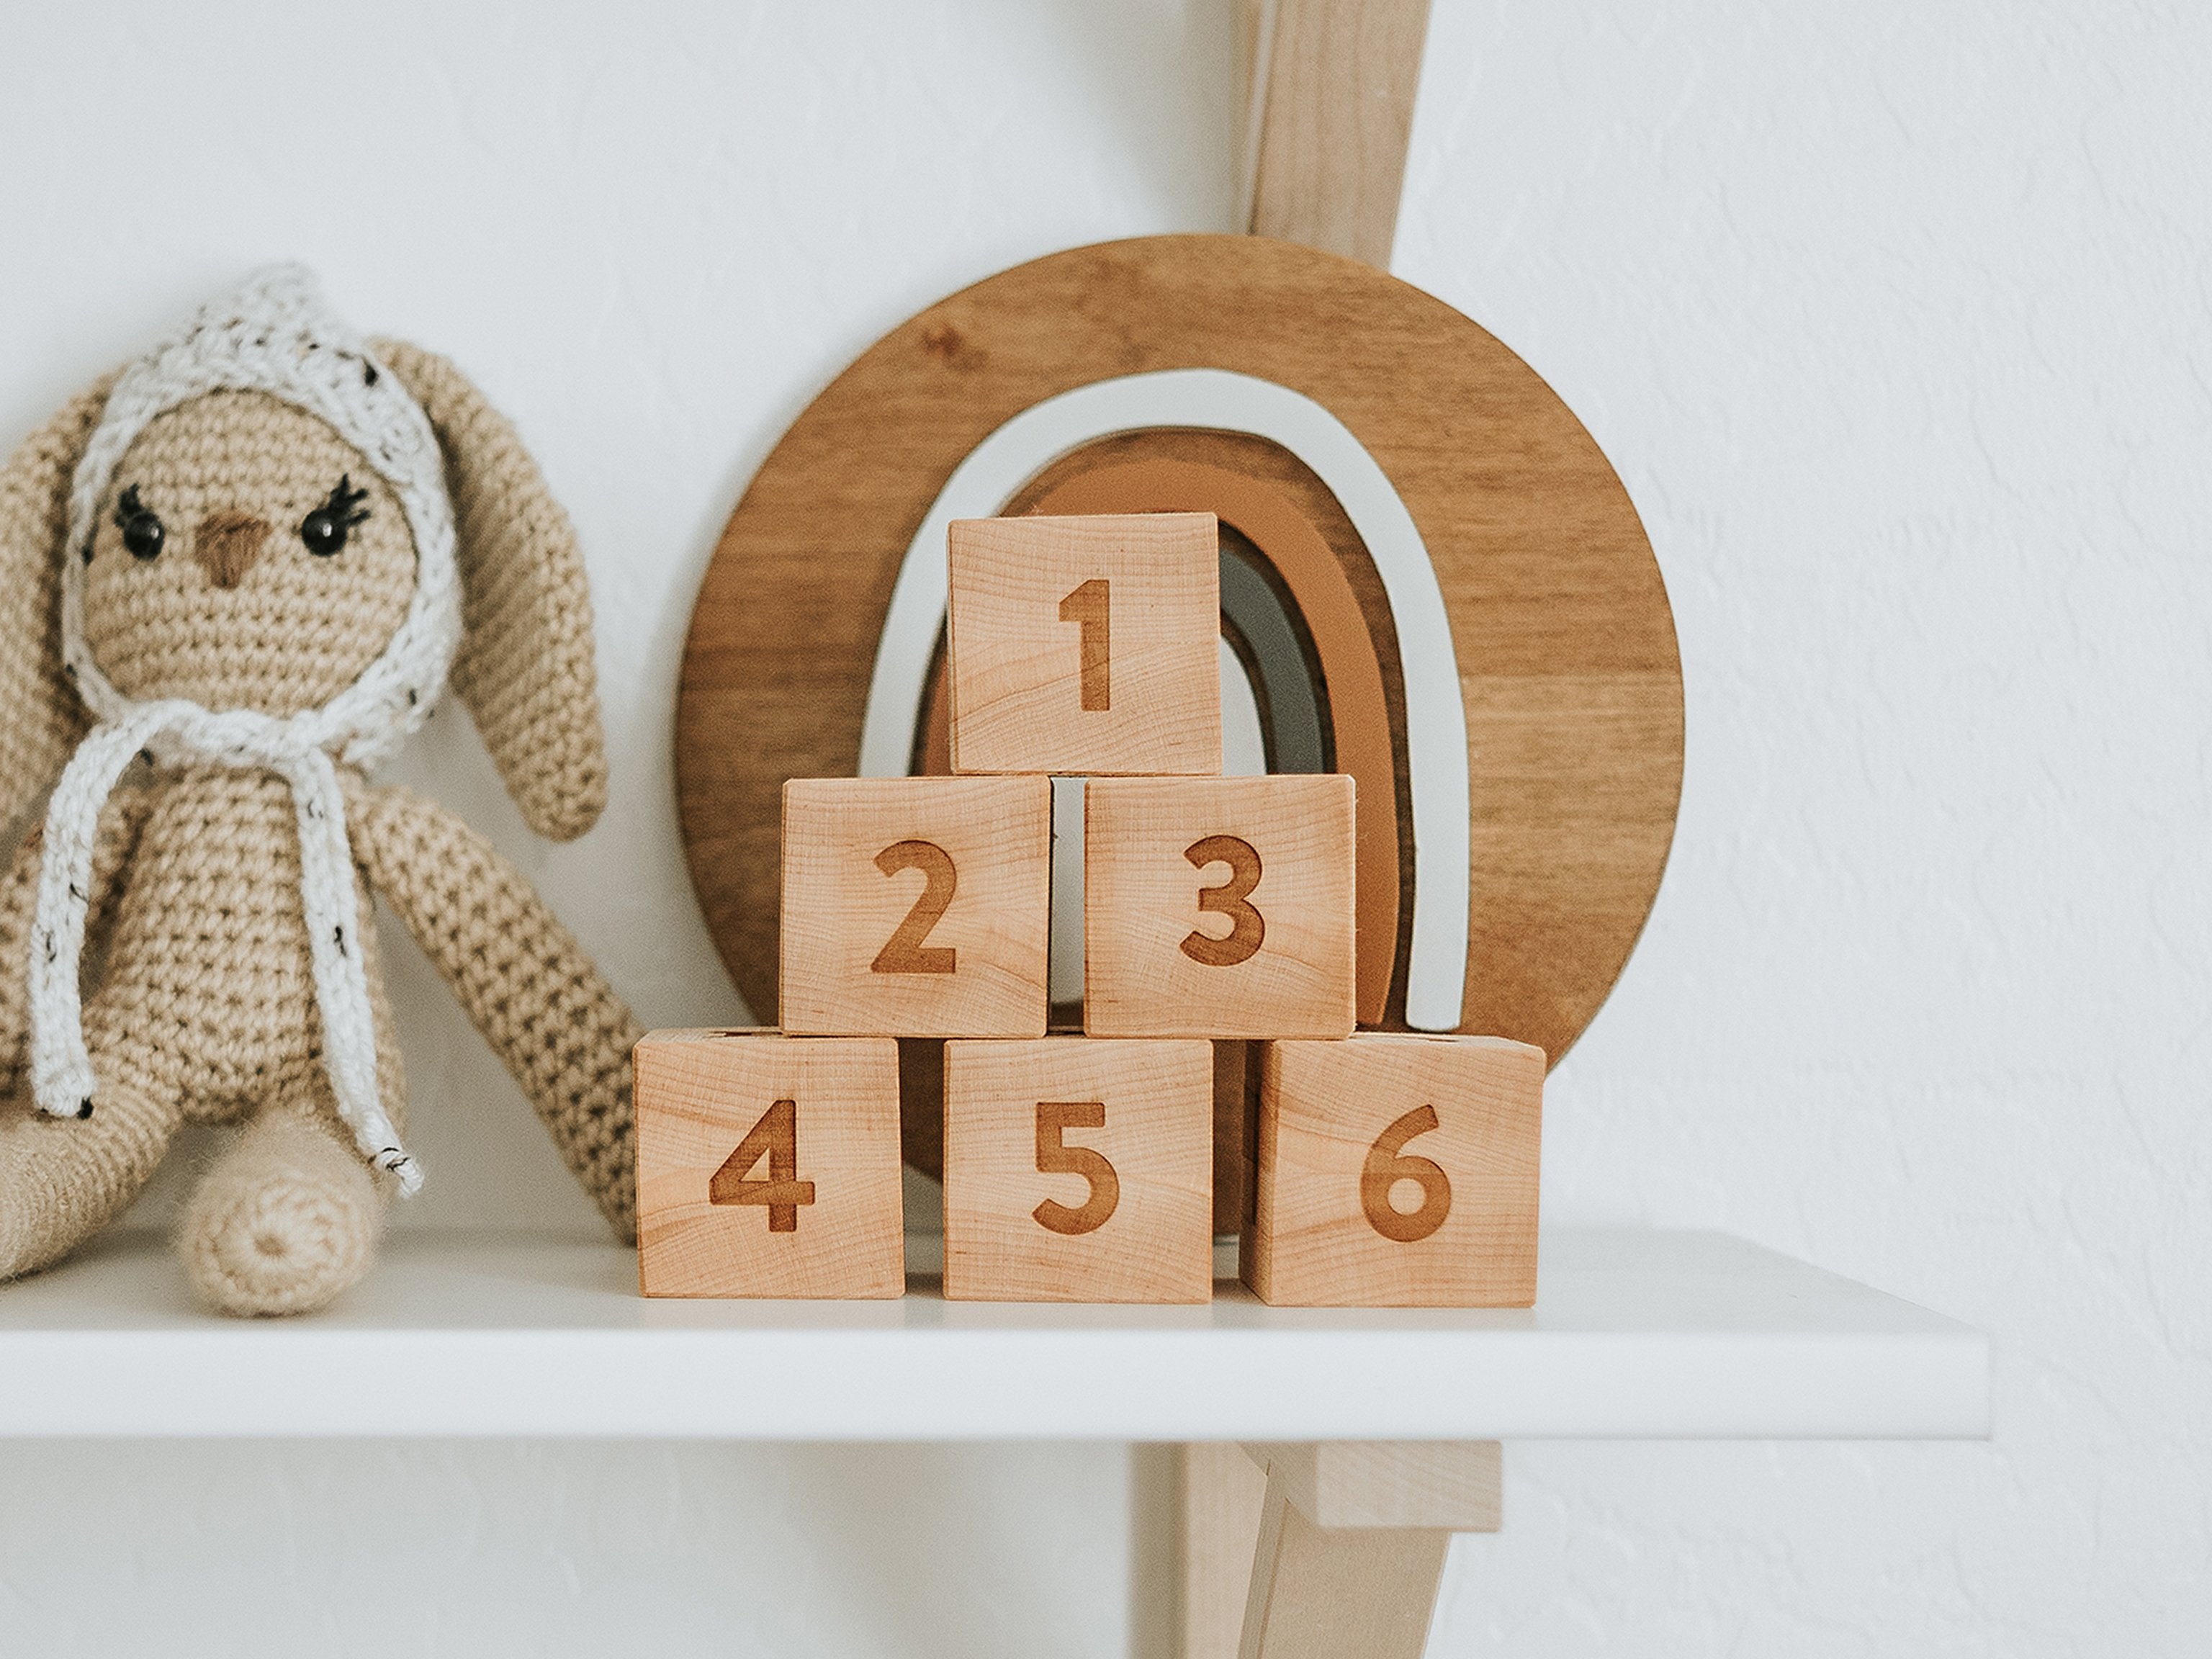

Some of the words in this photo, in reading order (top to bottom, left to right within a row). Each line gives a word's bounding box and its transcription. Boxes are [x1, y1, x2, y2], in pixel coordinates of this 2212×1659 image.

[1059, 579, 1110, 711] 1
[871, 840, 958, 974] 2
[1179, 835, 1265, 966] 3
[709, 1098, 815, 1232] 4
[1032, 1101, 1120, 1235] 5
[1360, 1104, 1452, 1243] 6
